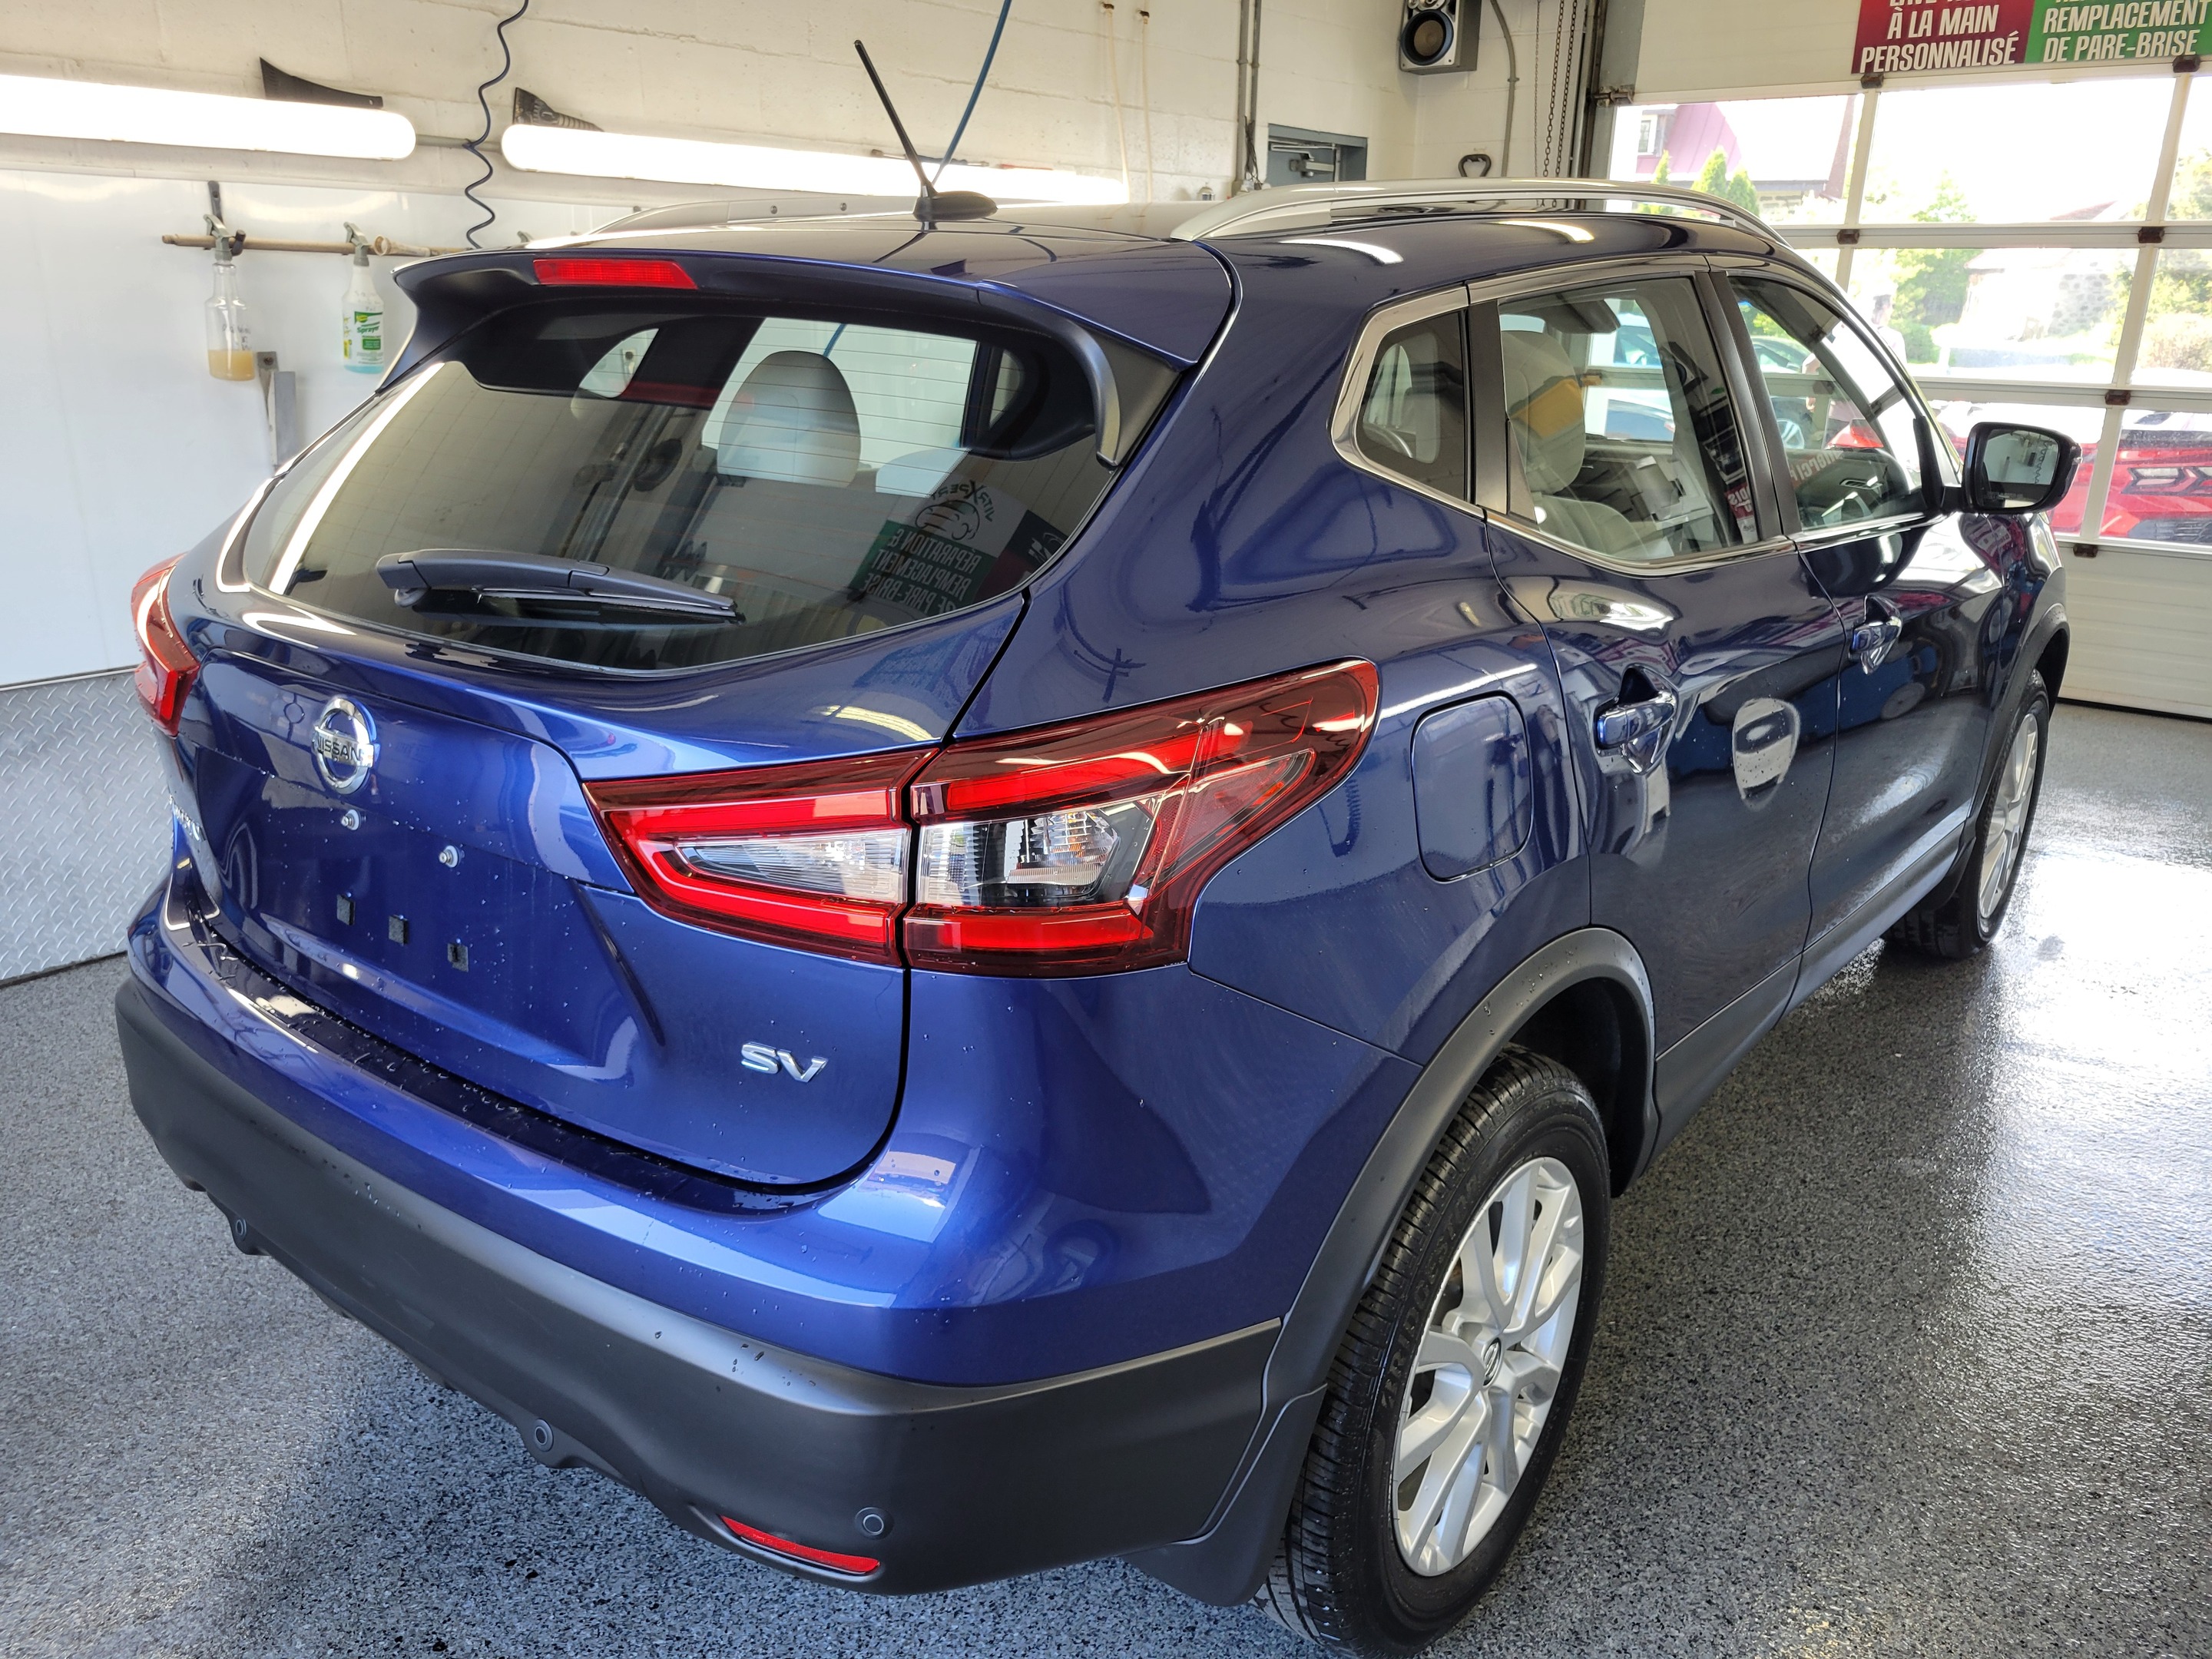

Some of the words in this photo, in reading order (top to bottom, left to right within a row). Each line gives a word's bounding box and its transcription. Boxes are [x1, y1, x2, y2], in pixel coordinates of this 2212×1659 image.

[1886, 6, 1903, 39] À
[1908, 10, 1933, 38] LA
[1939, 5, 1999, 36] MAIN
[2042, 0, 2212, 34] REMPLACEMENT
[1859, 31, 2019, 73] PERSONNALISÉ
[2043, 37, 2071, 63] DE
[2074, 29, 2200, 61] PARE-BRISE
[741, 1041, 829, 1083] SV
